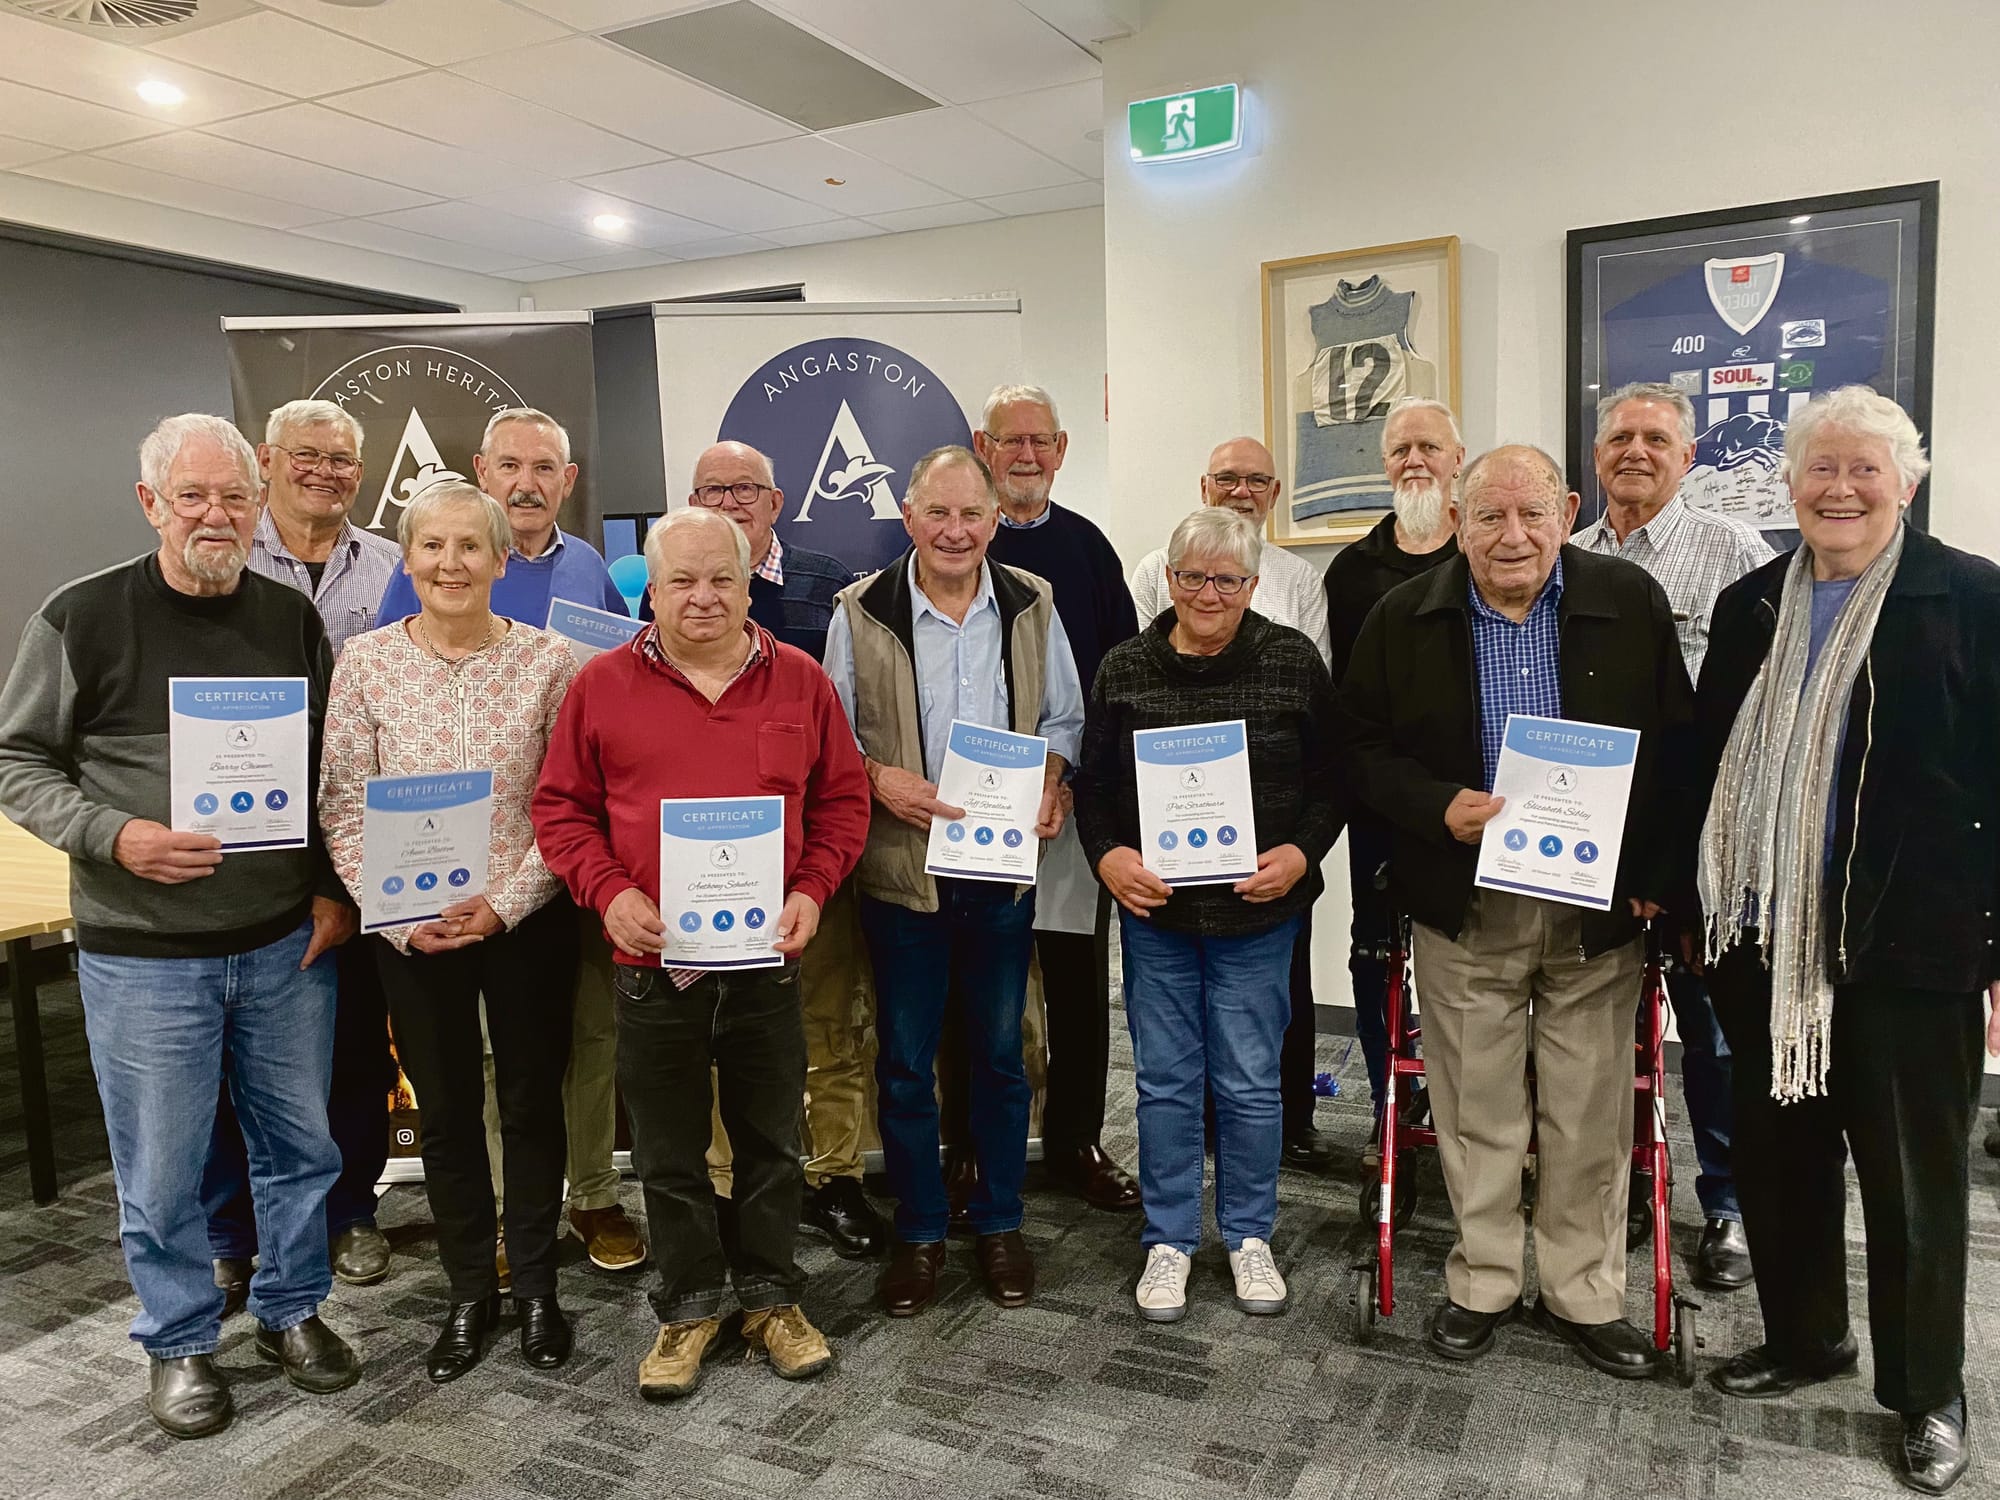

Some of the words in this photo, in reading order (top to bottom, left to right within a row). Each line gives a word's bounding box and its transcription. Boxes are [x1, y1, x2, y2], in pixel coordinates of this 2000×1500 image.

[1671, 334, 1705, 355] 400
[334, 360, 411, 407] ASTON
[427, 360, 509, 413] HERITA
[763, 352, 926, 402] ANGASTON
[1328, 343, 1391, 421] 12
[194, 691, 286, 702] CERTIFICATE
[964, 735, 1030, 756] CERTIFICATE
[1152, 734, 1228, 751] CERTIFICATE
[1525, 730, 1615, 751] CERTIFICATE
[387, 780, 473, 799] CERTIFICATE
[682, 810, 765, 823] CERTIFICATE
[687, 881, 724, 891] Anthony
